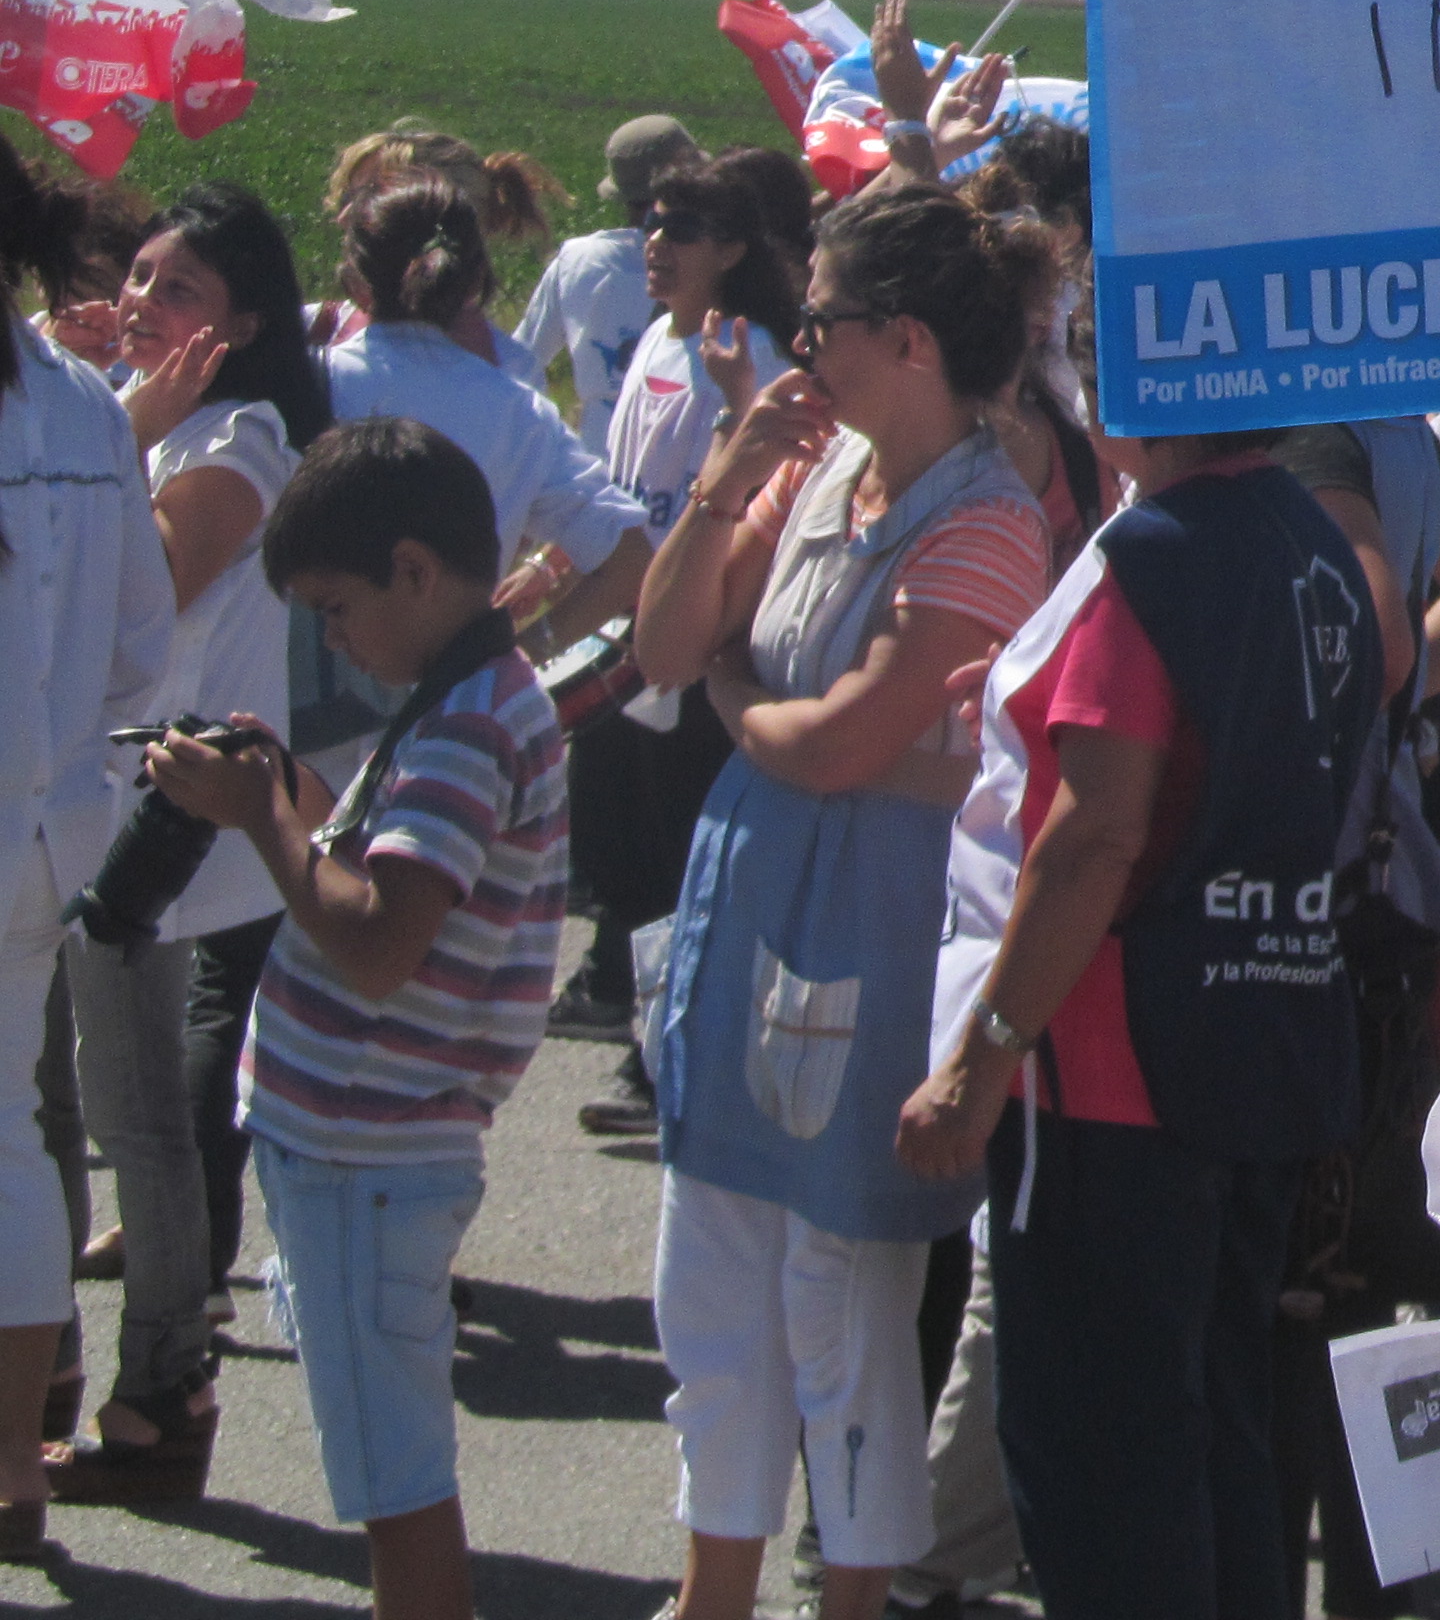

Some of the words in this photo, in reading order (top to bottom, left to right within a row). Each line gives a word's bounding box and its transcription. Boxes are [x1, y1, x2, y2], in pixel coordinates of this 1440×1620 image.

[1132, 278, 1238, 361] LA
[1137, 375, 1187, 405] Por
[1195, 368, 1268, 402] IOMA
[1302, 361, 1352, 391] Por
[1204, 870, 1275, 921] En
[1256, 933, 1280, 954] de
[1284, 934, 1302, 954] la
[1202, 962, 1220, 987] y
[1222, 960, 1240, 981] la
